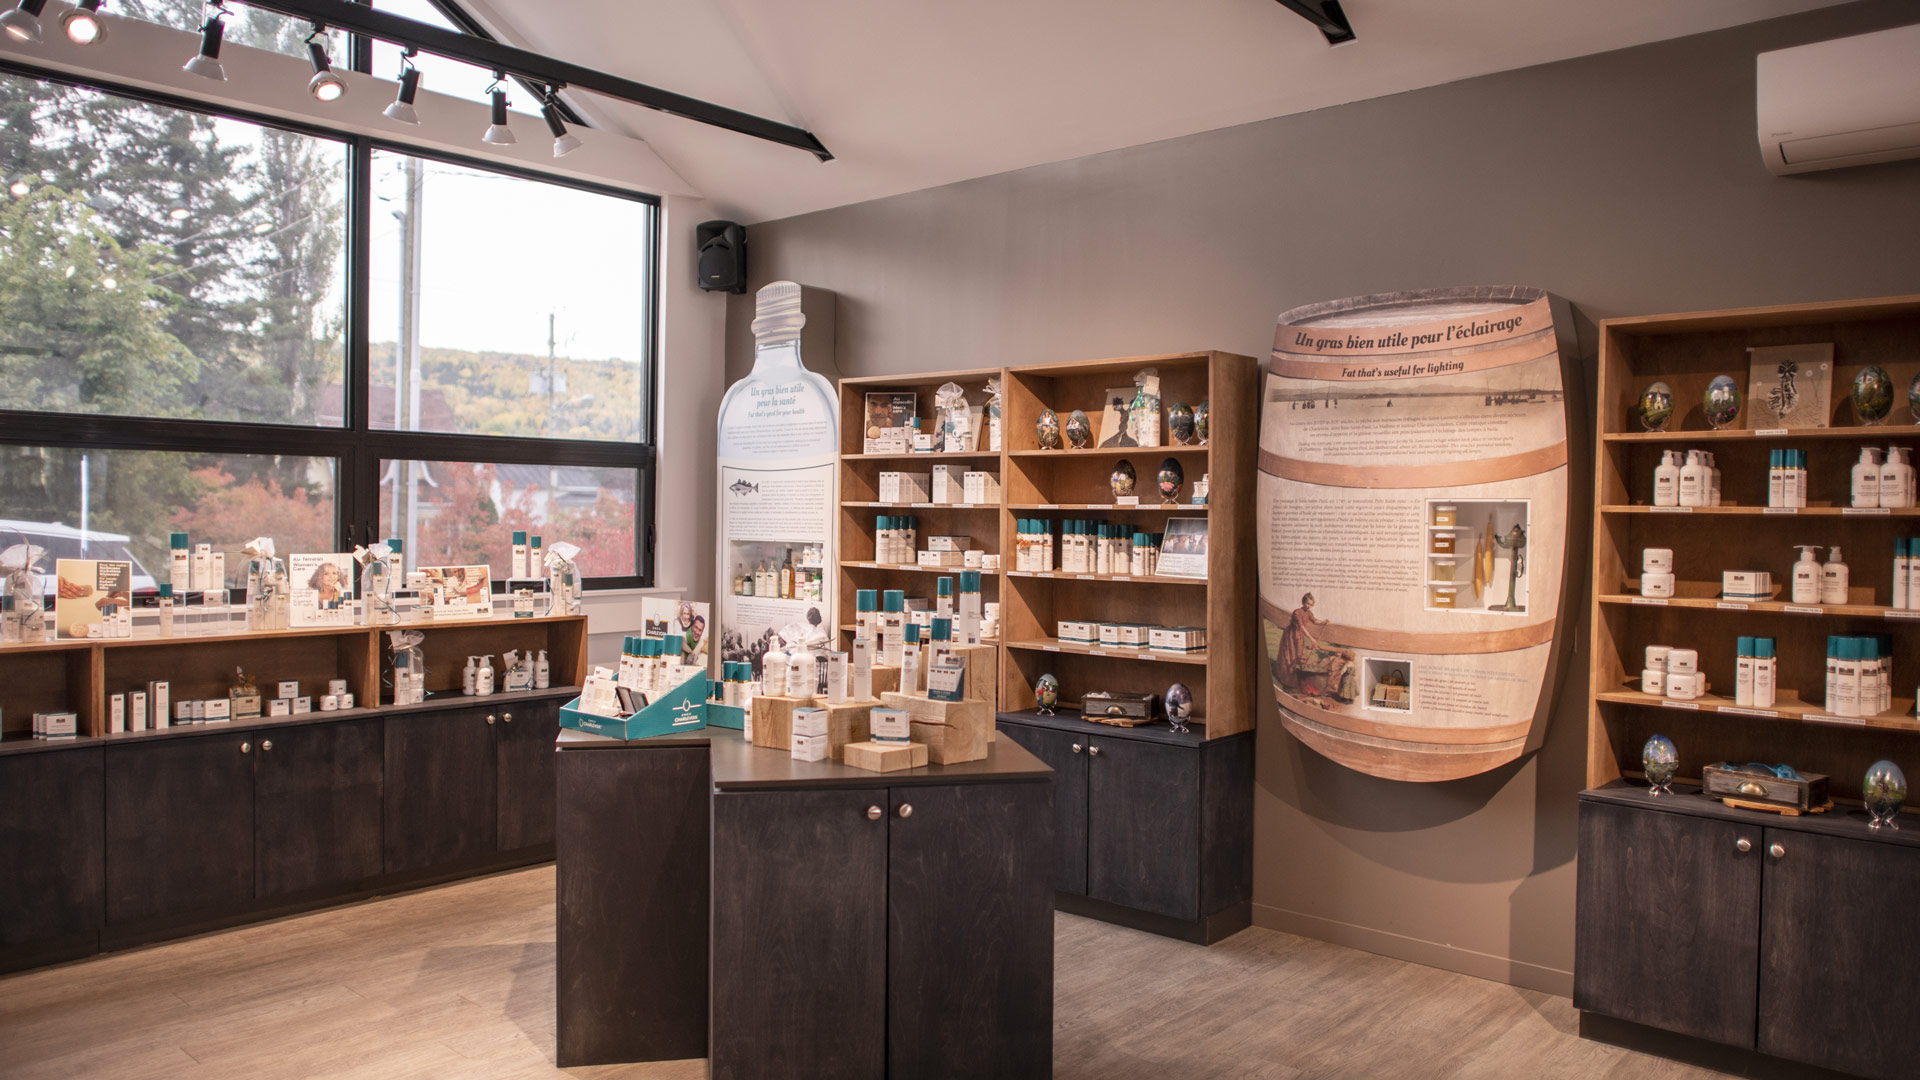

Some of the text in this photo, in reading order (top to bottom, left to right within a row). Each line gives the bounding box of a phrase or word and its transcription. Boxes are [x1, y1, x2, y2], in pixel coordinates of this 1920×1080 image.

[1295, 331, 1313, 348] Un
[1316, 335, 1343, 352] gras
[1345, 331, 1374, 350] bien
[1377, 330, 1409, 348] utile
[1411, 331, 1444, 351] pour
[1341, 366, 1357, 378] Fat
[1383, 363, 1411, 378] useful
[1412, 363, 1426, 378] for
[1426, 359, 1465, 376] lighting
[750, 382, 805, 397] Un gras bien utile
[756, 398, 771, 409] pour
[779, 395, 796, 405] santé
